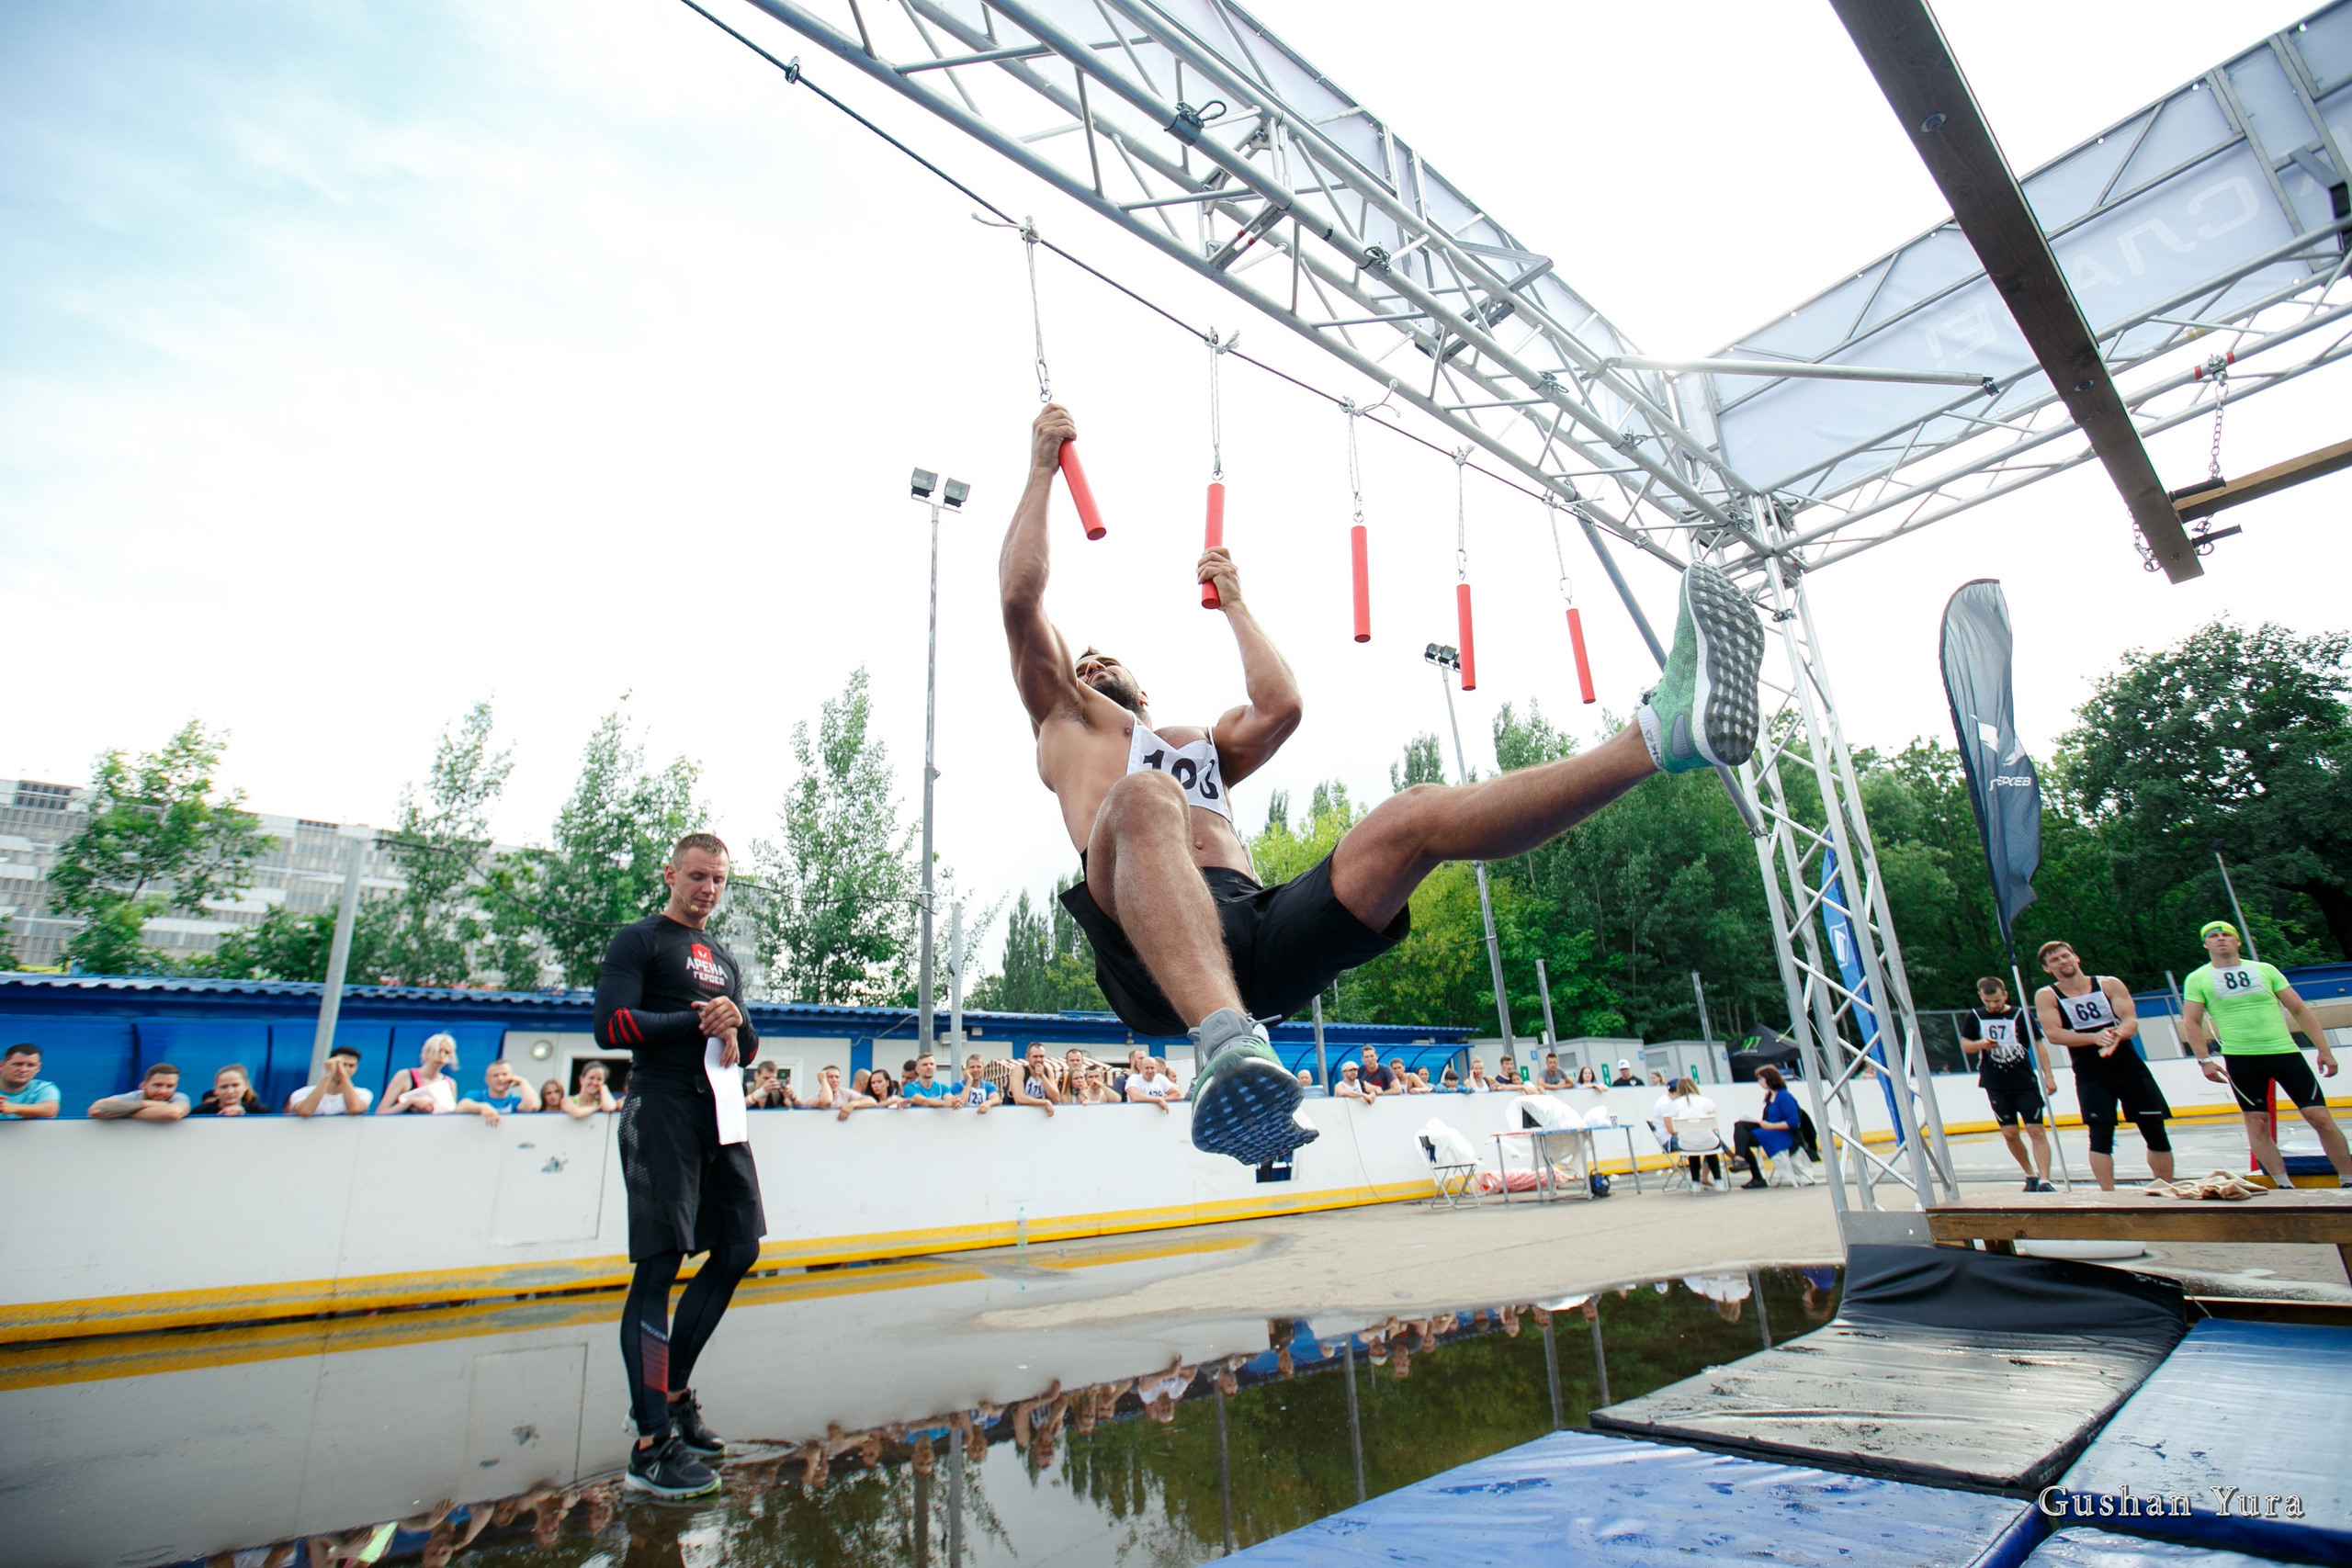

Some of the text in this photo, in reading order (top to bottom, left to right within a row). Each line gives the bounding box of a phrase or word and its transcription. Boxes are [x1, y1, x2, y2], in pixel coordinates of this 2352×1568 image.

[685, 956, 729, 979] АРЕНА
[693, 971, 725, 986] ГЕРОЕВ
[2224, 971, 2251, 989] 88
[2075, 1001, 2101, 1021] 68
[1989, 1024, 2007, 1040] 67
